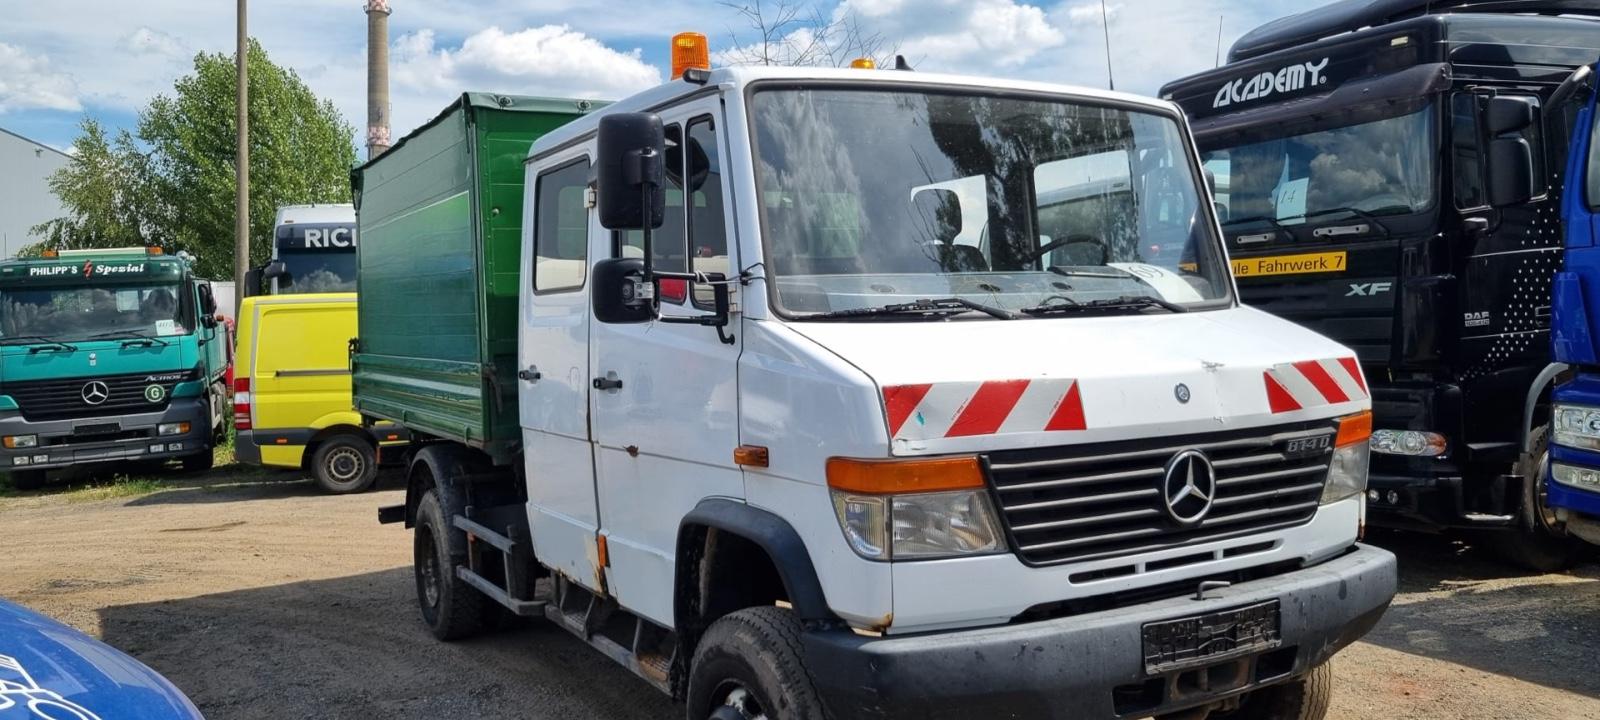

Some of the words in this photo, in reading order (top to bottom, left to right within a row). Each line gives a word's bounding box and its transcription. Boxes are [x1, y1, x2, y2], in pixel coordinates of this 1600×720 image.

[95, 263, 145, 275] Spezial
[1257, 258, 1328, 274] Fahrwerk
[1334, 255, 1343, 269] 7
[1344, 282, 1392, 297] XF
[1464, 311, 1490, 320] DAF
